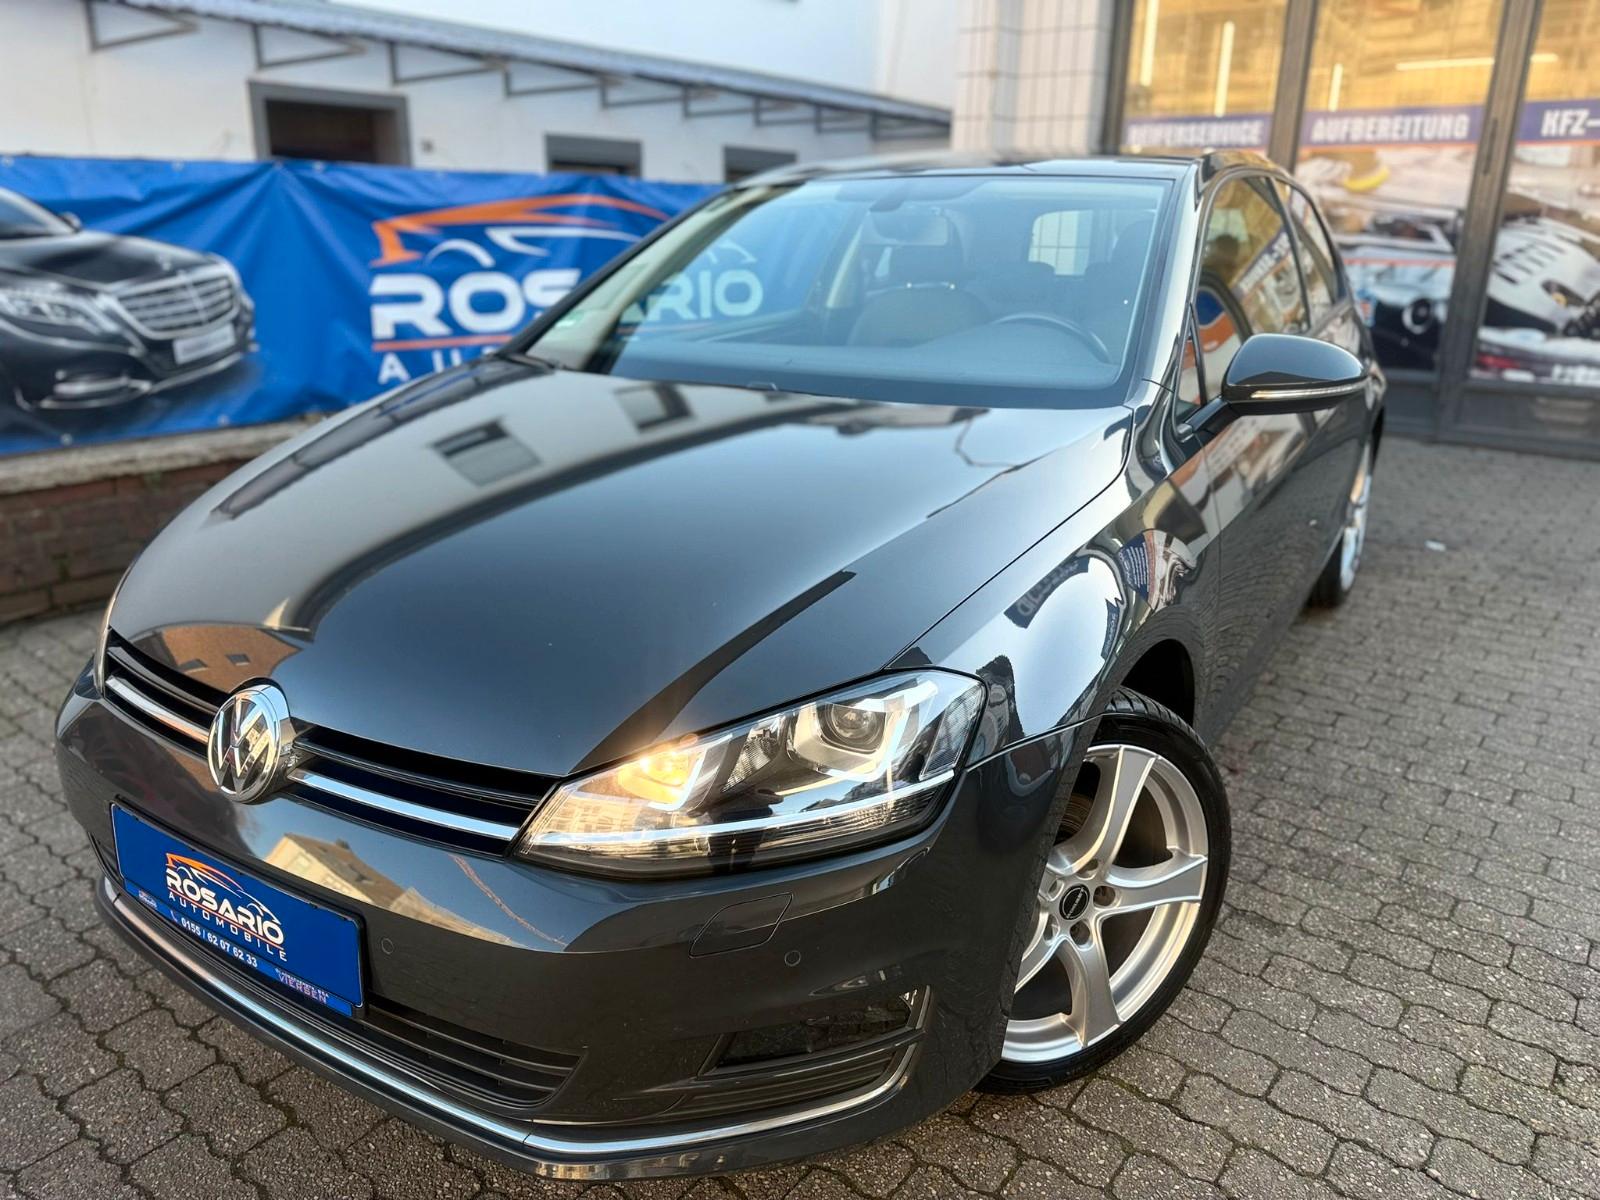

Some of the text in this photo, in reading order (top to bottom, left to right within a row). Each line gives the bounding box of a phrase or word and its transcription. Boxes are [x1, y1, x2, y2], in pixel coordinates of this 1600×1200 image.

[1311, 104, 1471, 142] AUFBEREITUNG
[166, 868, 284, 945] ROSARIO
[168, 891, 288, 962] AUTOMOBILE
[181, 917, 202, 936] 0155
[207, 933, 219, 946] 62
[220, 939, 231, 954] 07
[232, 947, 245, 961] 62
[245, 954, 258, 968] 33
